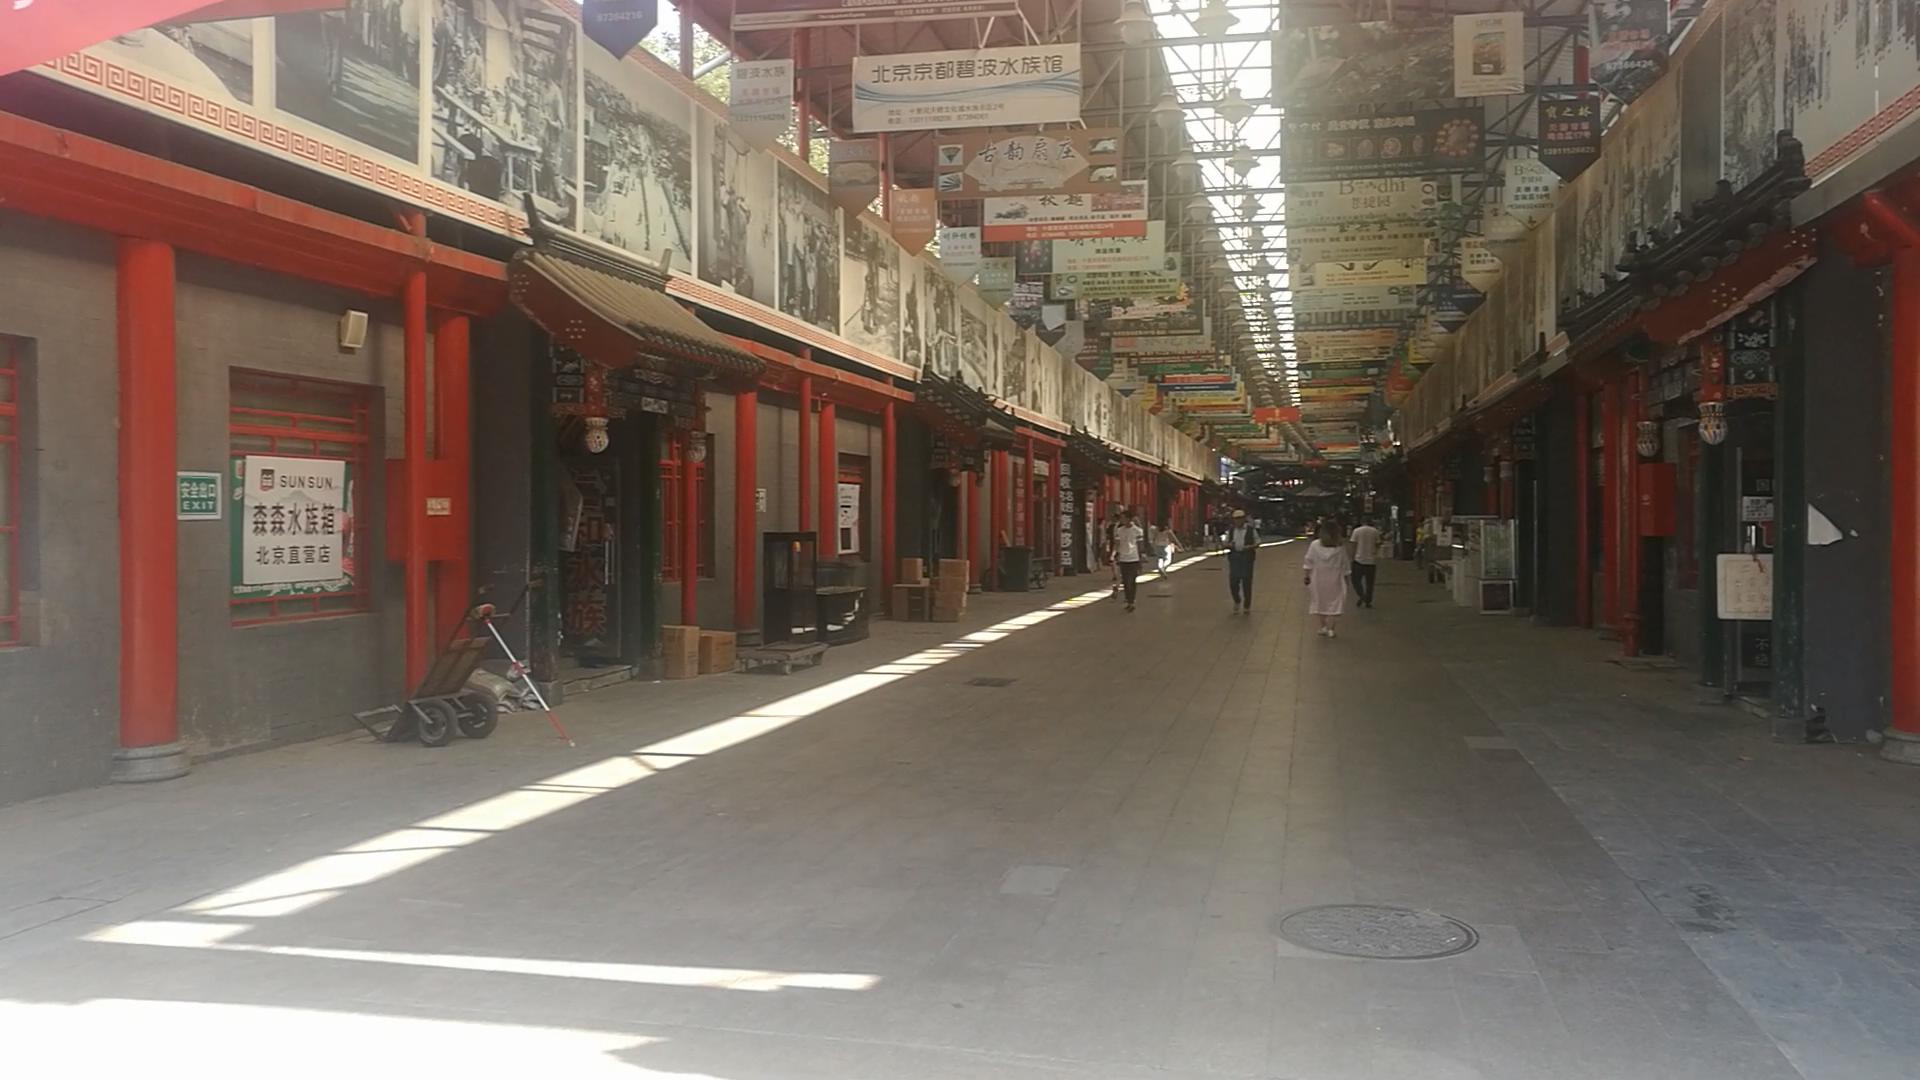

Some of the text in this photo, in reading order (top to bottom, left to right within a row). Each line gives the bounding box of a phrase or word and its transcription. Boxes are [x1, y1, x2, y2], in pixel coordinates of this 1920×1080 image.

[871, 55, 1064, 84] 北京京都碧波水族馆
[978, 138, 1076, 163] 古韵扇庄
[181, 481, 217, 499] 安全出口
[279, 474, 335, 490] SUNSUN
[182, 500, 215, 511] EXIT
[252, 502, 336, 537] 森森水族箱
[255, 545, 331, 566] 北京直营店
